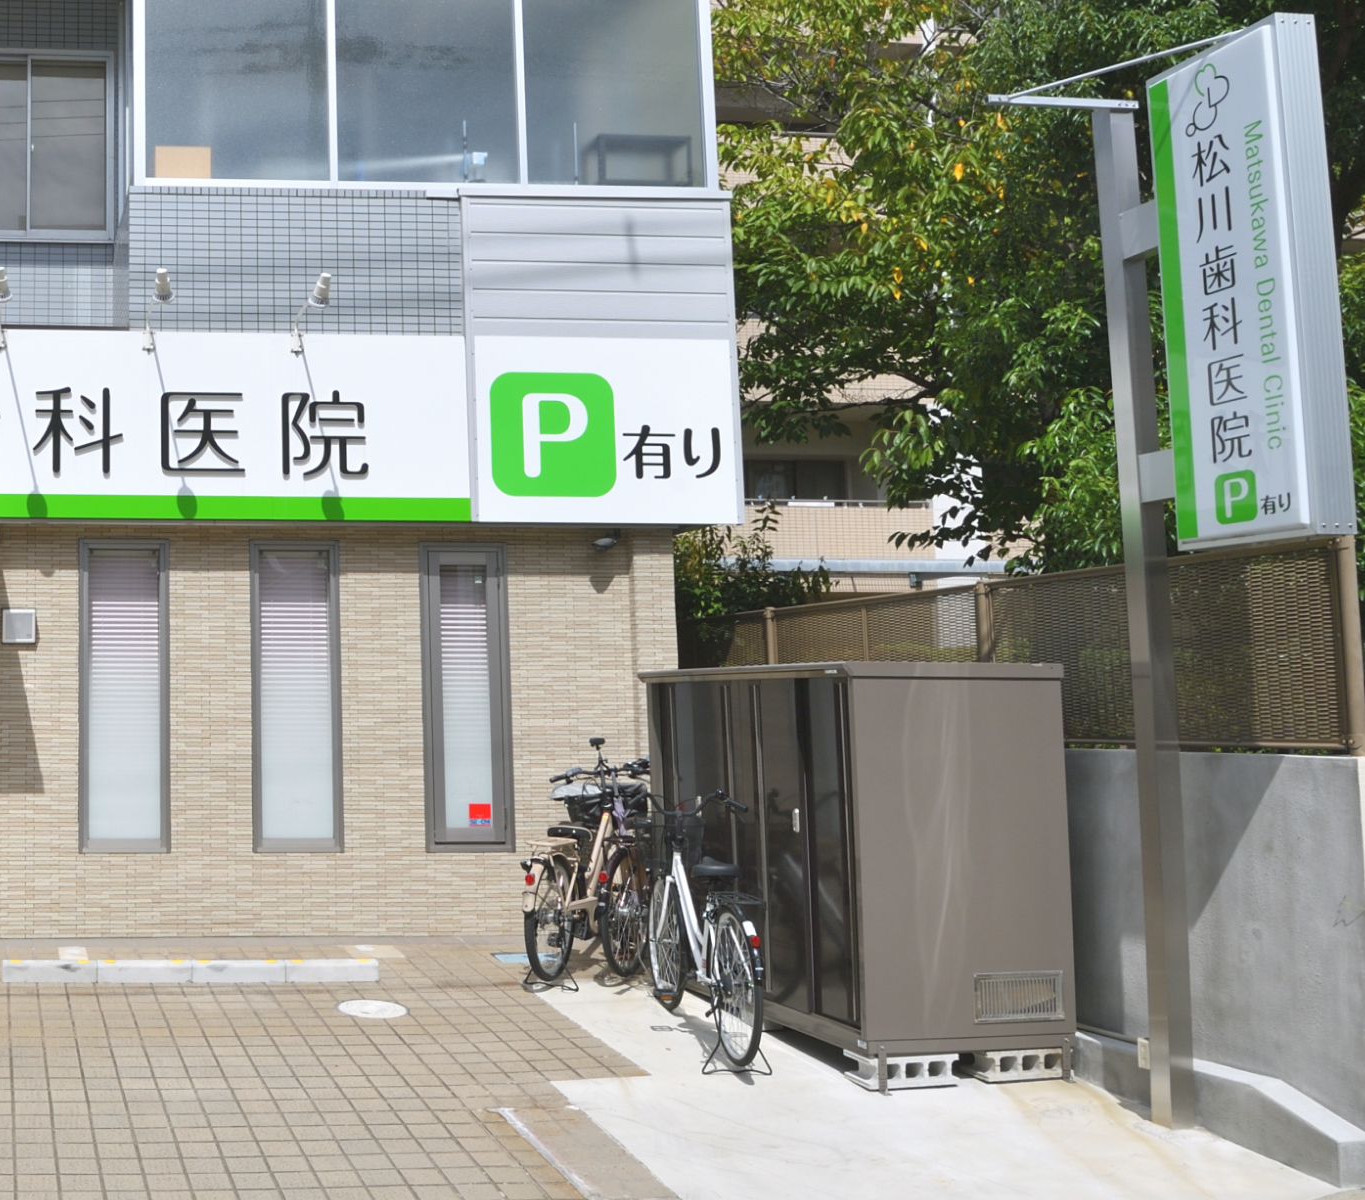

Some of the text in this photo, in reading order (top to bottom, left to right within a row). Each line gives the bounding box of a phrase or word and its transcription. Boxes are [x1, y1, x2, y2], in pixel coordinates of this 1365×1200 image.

[1190, 133, 1253, 465] 松川歯科医院
[1243, 119, 1285, 450] Matsukawa Dental Clinic
[622, 424, 721, 480] 有り
[1260, 492, 1292, 516] 有り
